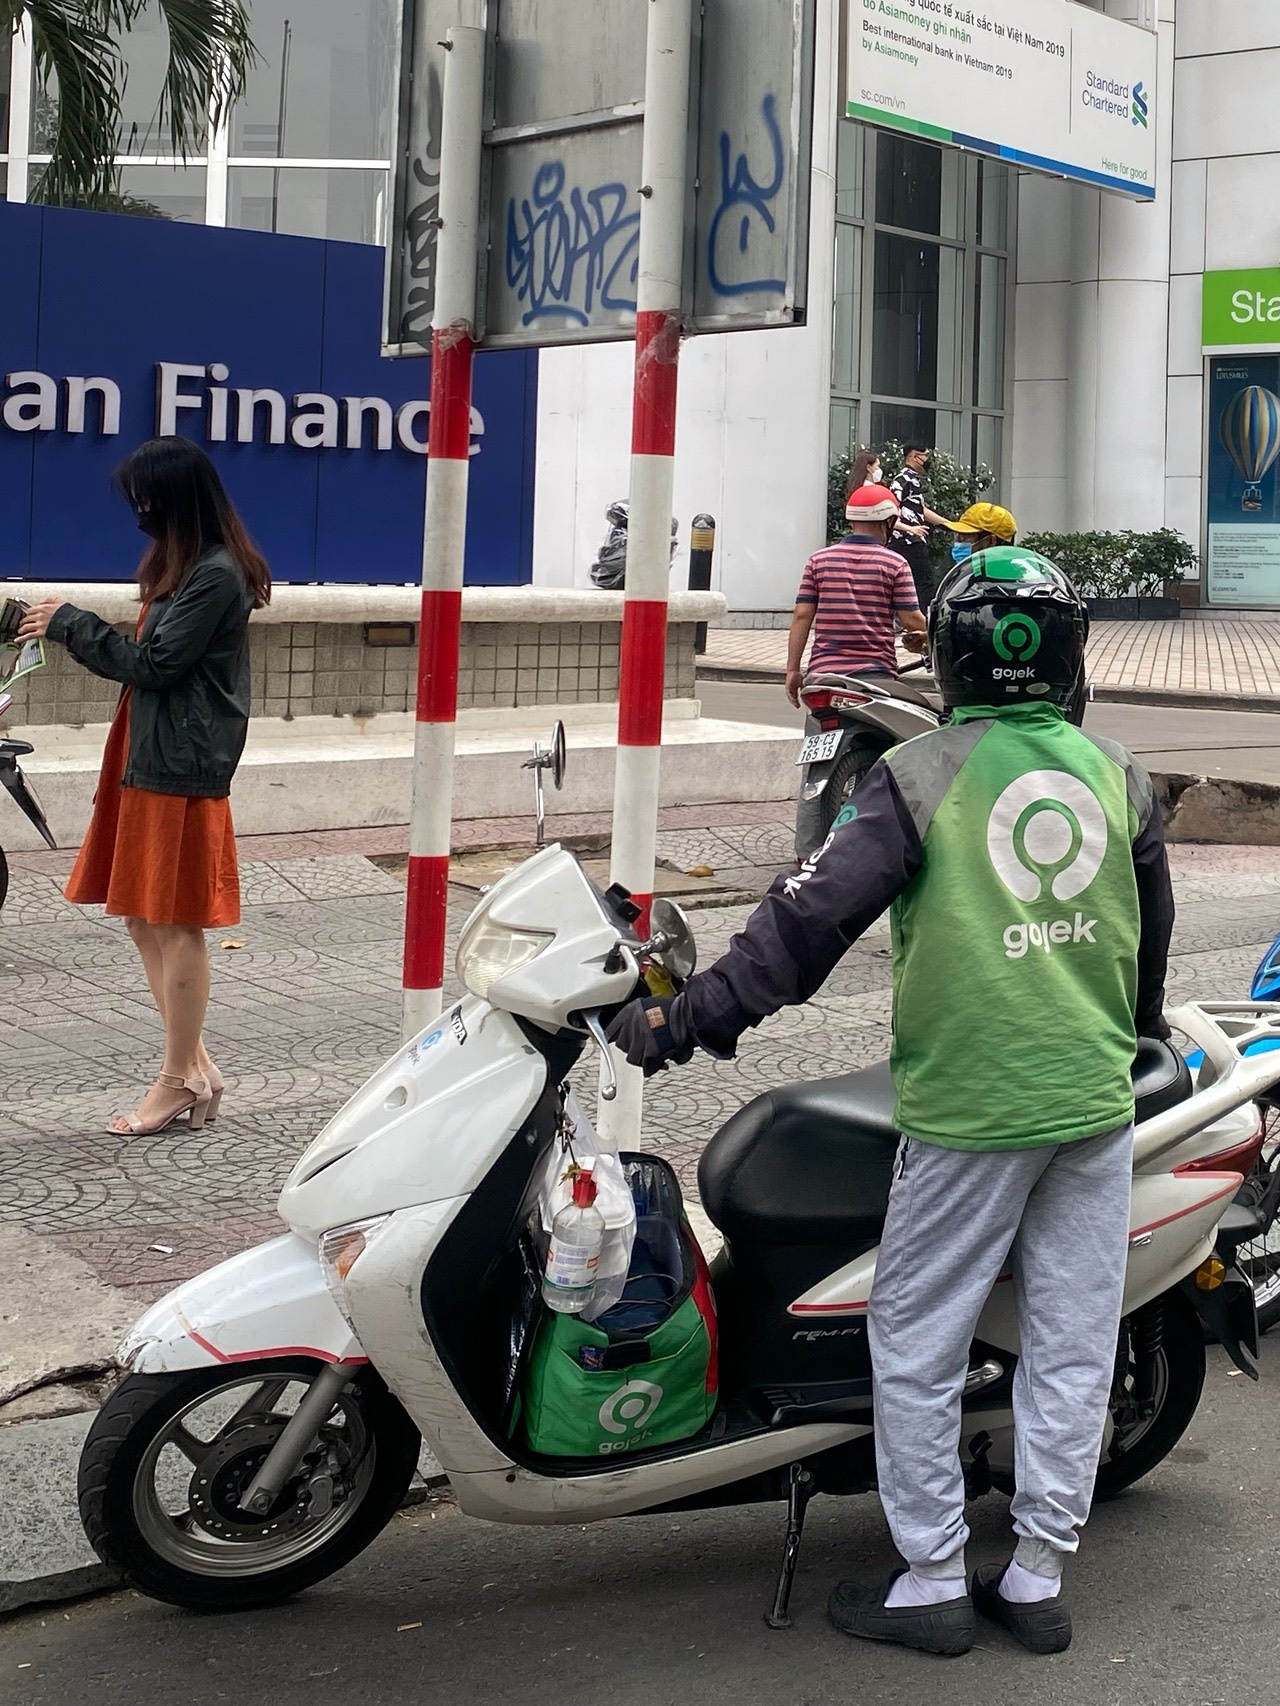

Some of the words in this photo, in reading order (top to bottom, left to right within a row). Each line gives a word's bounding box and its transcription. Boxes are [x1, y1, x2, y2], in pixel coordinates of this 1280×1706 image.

[878, 1, 931, 32] Asiamoney
[932, 21, 947, 37] ghi
[949, 26, 972, 45] nhận
[944, 3, 953, 17] tế
[955, 9, 975, 26] xuất
[976, 15, 992, 32] sắc
[994, 22, 1005, 38] tại
[1006, 25, 1023, 44] Việt
[1024, 33, 1044, 51] Nam
[1045, 41, 1065, 58] 2019
[862, 20, 882, 36] Best
[883, 26, 933, 52] international
[934, 45, 954, 60] bank
[955, 49, 963, 63] in
[964, 54, 994, 74] Vietnam
[995, 64, 1013, 80] 2019
[862, 36, 873, 51] by
[874, 41, 919, 67] Asiamoney
[1086, 71, 1129, 99] Standard
[861, 88, 906, 111] sc.com/vn
[1081, 90, 1129, 119] Chartered
[1101, 158, 1118, 173] Here
[1119, 161, 1129, 176] for
[1128, 166, 1148, 181] good
[993, 667, 1035, 681] gojek
[807, 733, 835, 748] 59-C3
[1003, 912, 1099, 958] gojek
[598, 1428, 653, 1454] gojek
